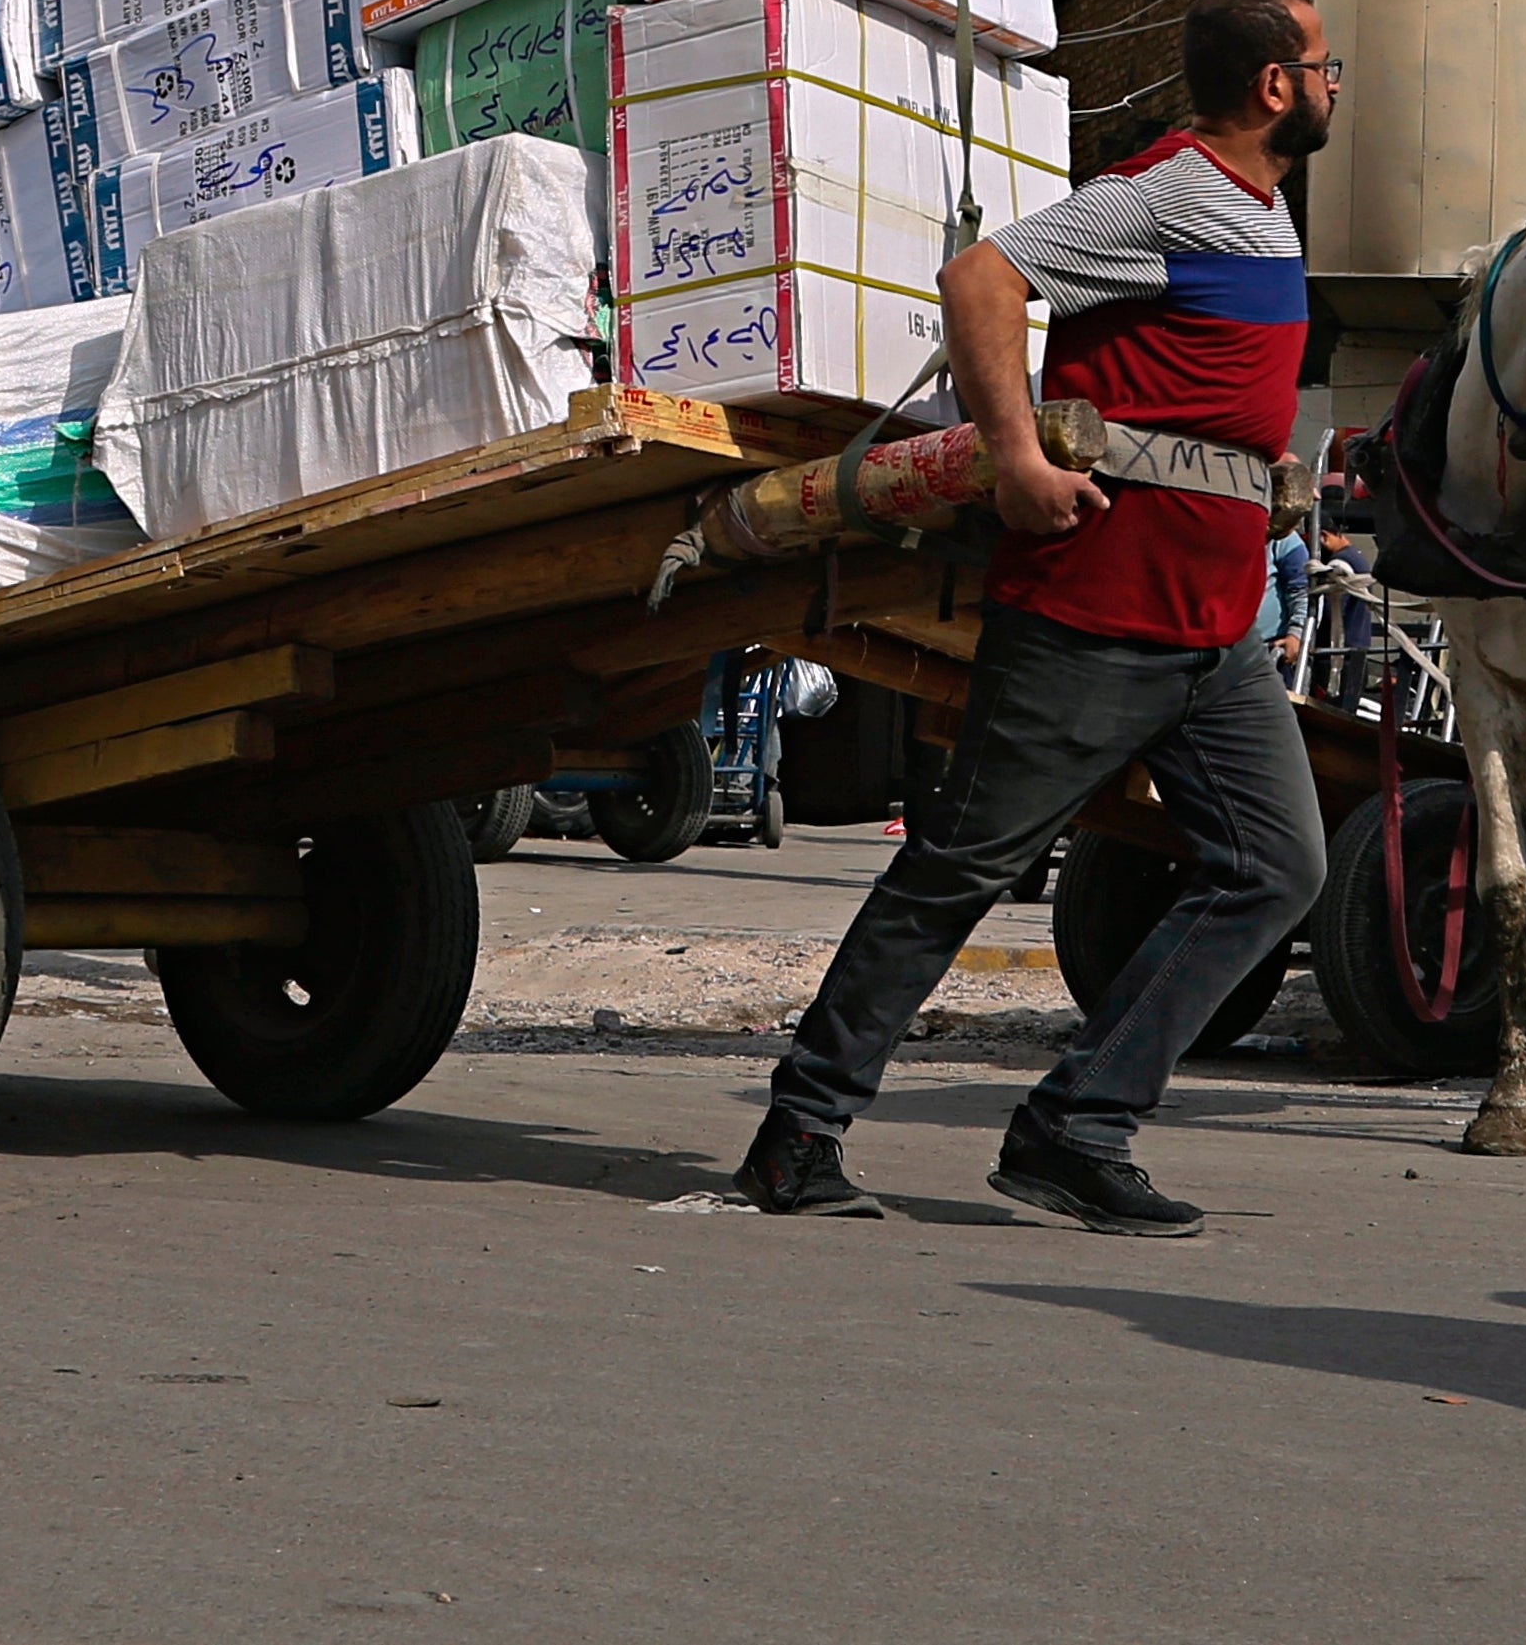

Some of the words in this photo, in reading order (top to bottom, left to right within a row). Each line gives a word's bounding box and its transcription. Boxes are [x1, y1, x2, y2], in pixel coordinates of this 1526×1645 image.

[234, 0, 246, 47] COLOR:
[237, 50, 252, 104] Z-1008
[776, 143, 788, 190] MTL
[618, 183, 630, 227] MTL
[780, 347, 794, 393] MTL
